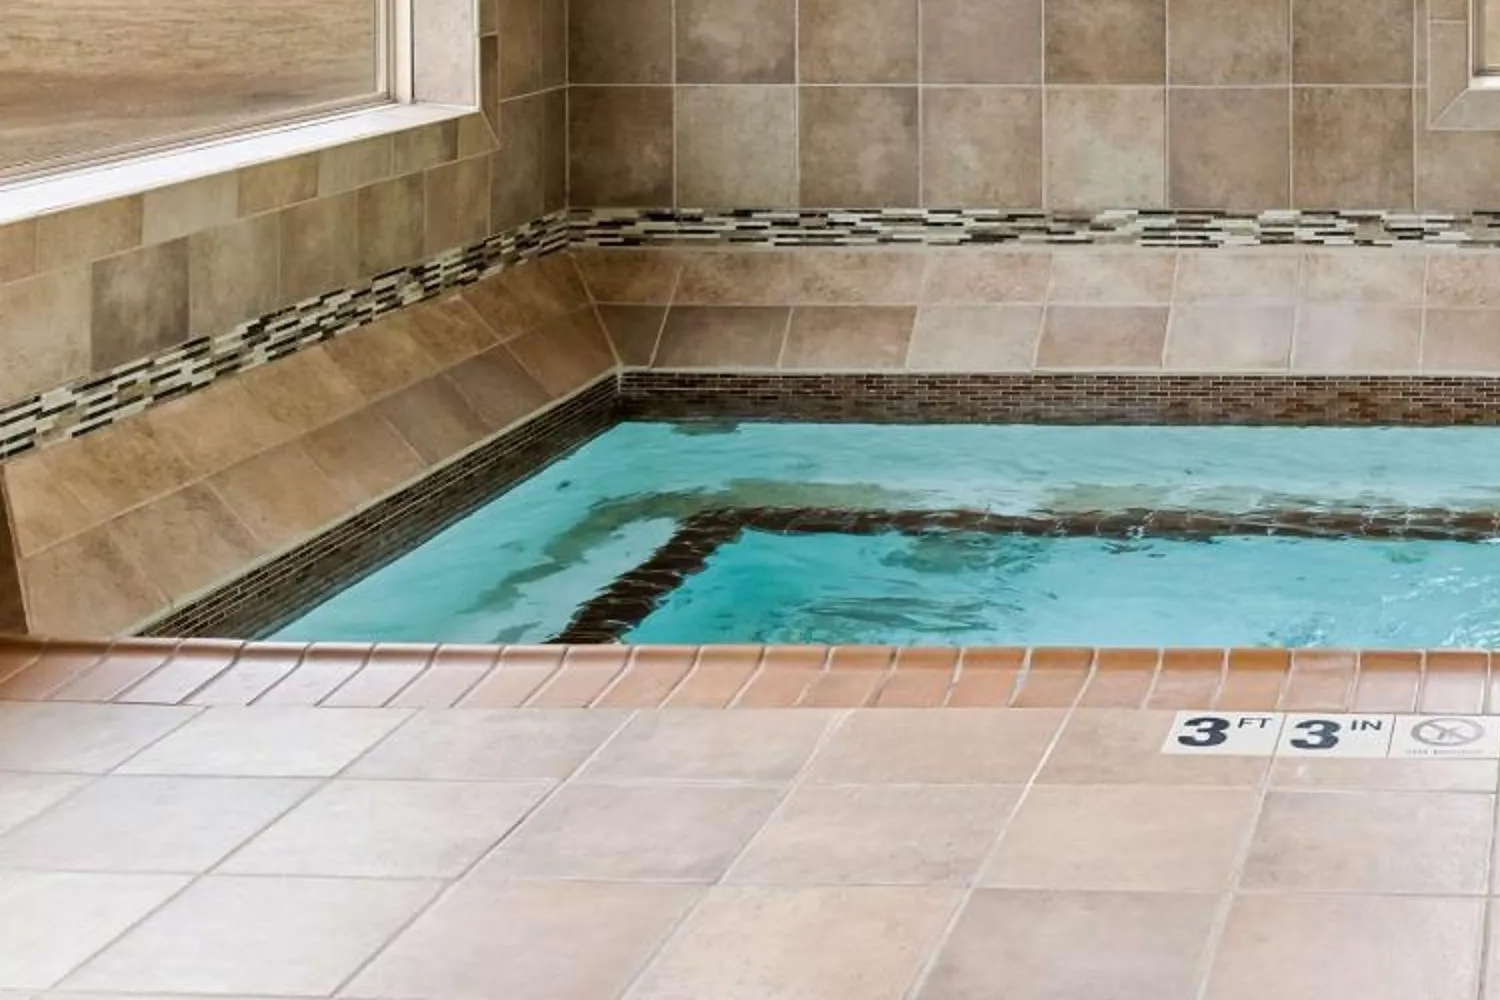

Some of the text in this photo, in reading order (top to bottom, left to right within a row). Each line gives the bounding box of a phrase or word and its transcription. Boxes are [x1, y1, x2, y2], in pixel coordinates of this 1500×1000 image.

[1177, 717, 1382, 750] 3 FT 3 IN
